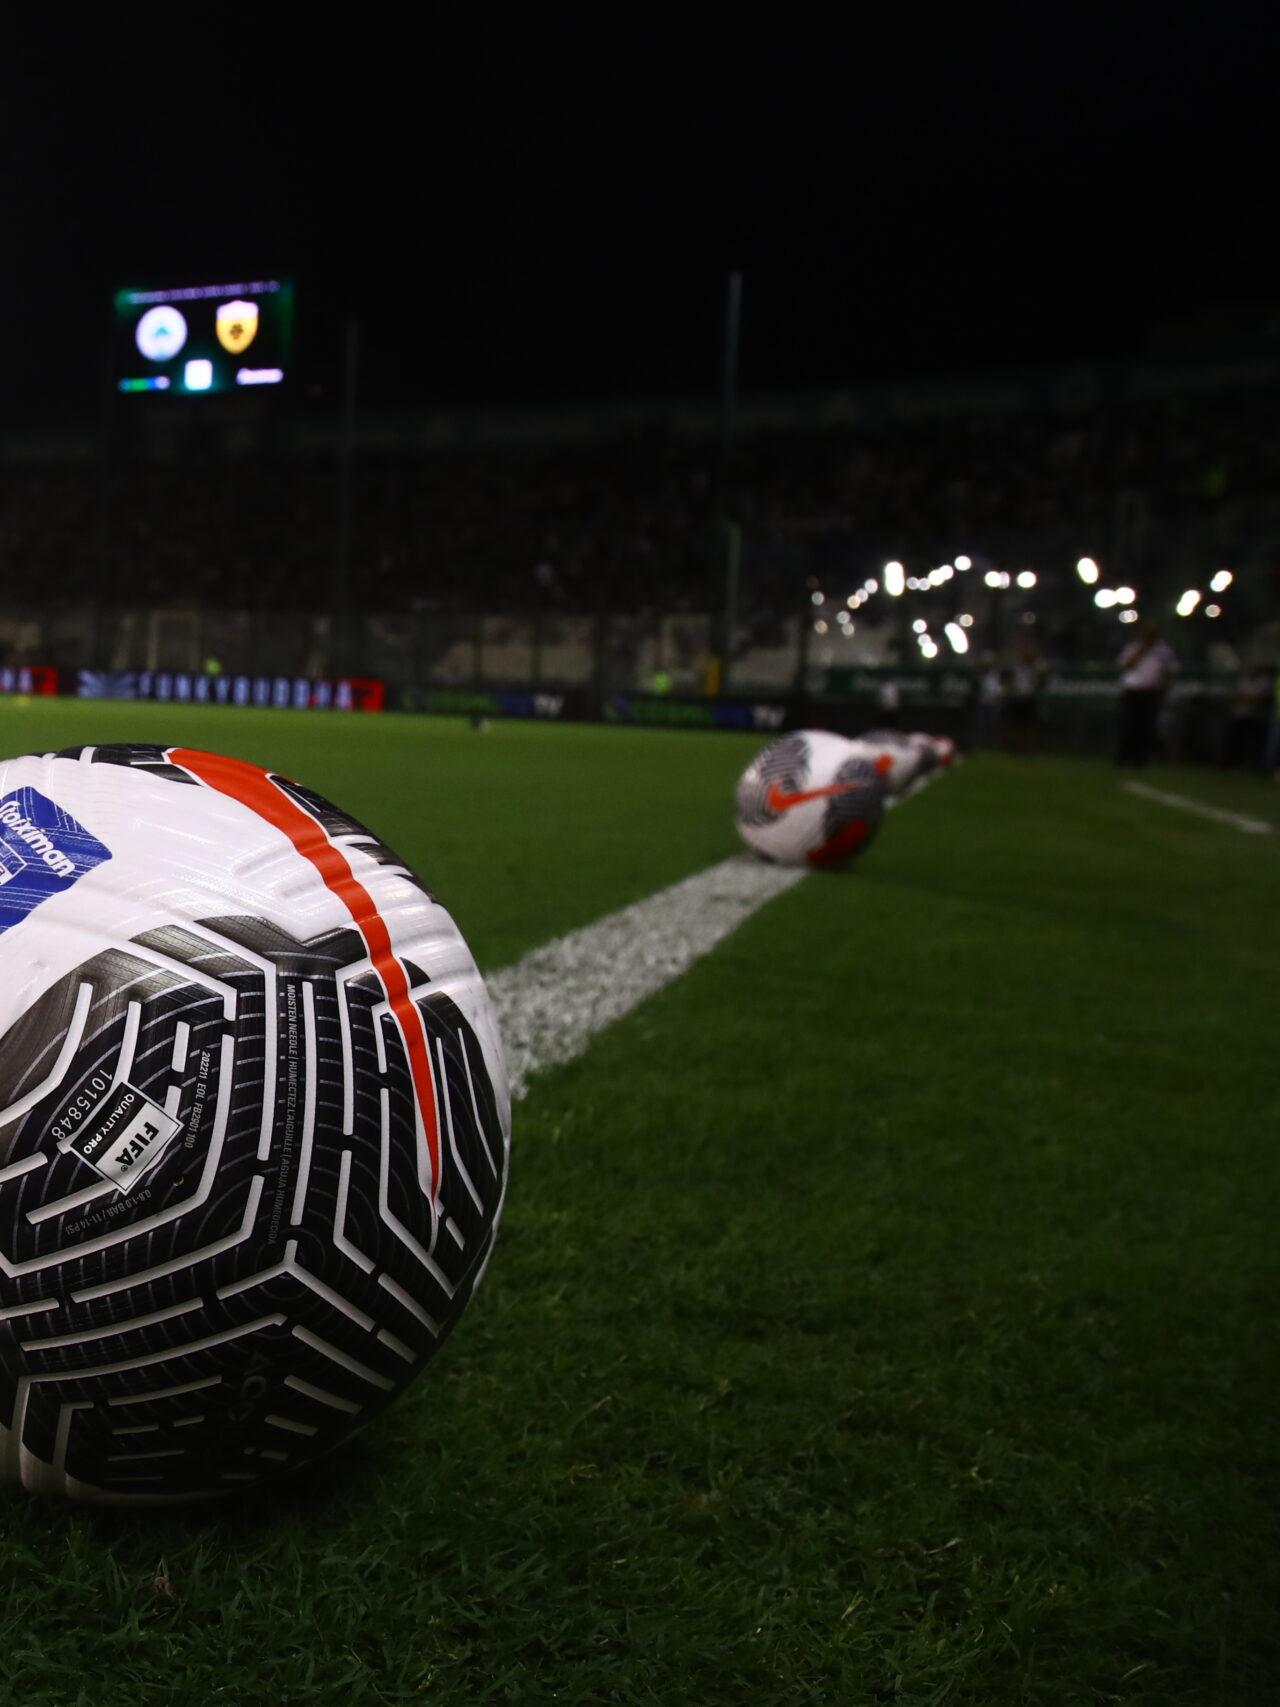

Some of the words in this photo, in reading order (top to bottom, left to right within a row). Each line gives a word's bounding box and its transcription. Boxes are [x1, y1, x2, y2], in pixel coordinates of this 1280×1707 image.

[286, 983, 297, 1021] MOISTEN
[287, 1022, 297, 1054] NEEDLE
[287, 1061, 297, 1107] HUMECTEZ
[51, 1068, 113, 1142] 1015848
[97, 1092, 135, 1136] QUALITY
[82, 1133, 103, 1155] PRO
